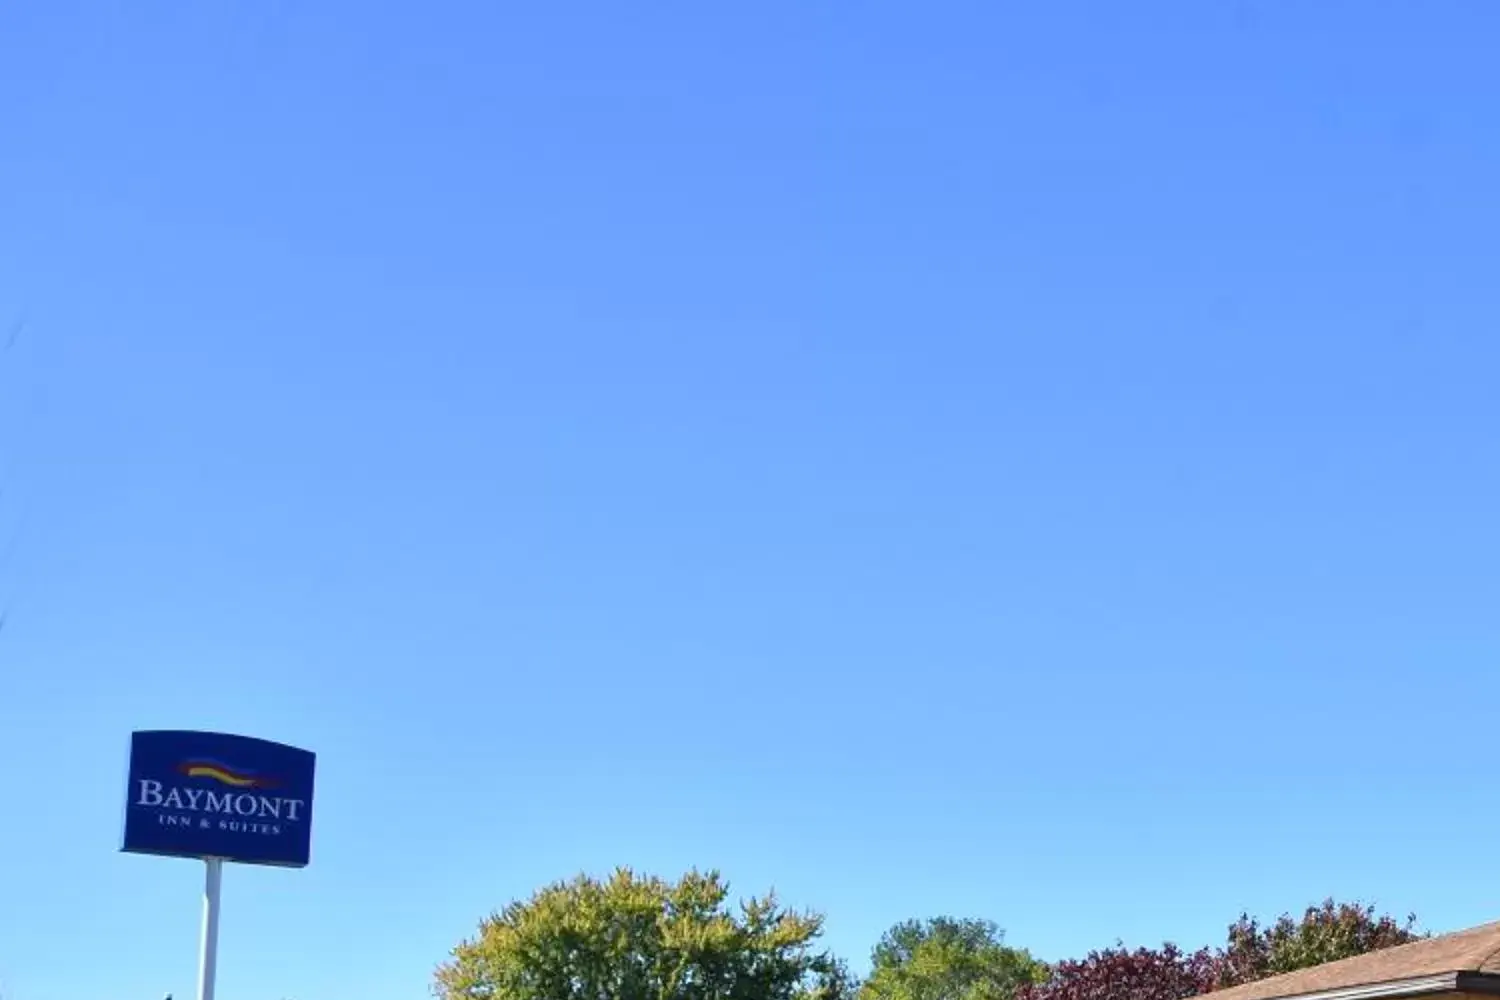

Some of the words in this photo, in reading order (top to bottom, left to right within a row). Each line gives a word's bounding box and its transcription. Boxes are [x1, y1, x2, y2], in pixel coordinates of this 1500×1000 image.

[137, 779, 304, 821] BAYMONT
[159, 814, 191, 827] INN
[200, 819, 210, 829] &
[219, 821, 281, 835] SUITES
